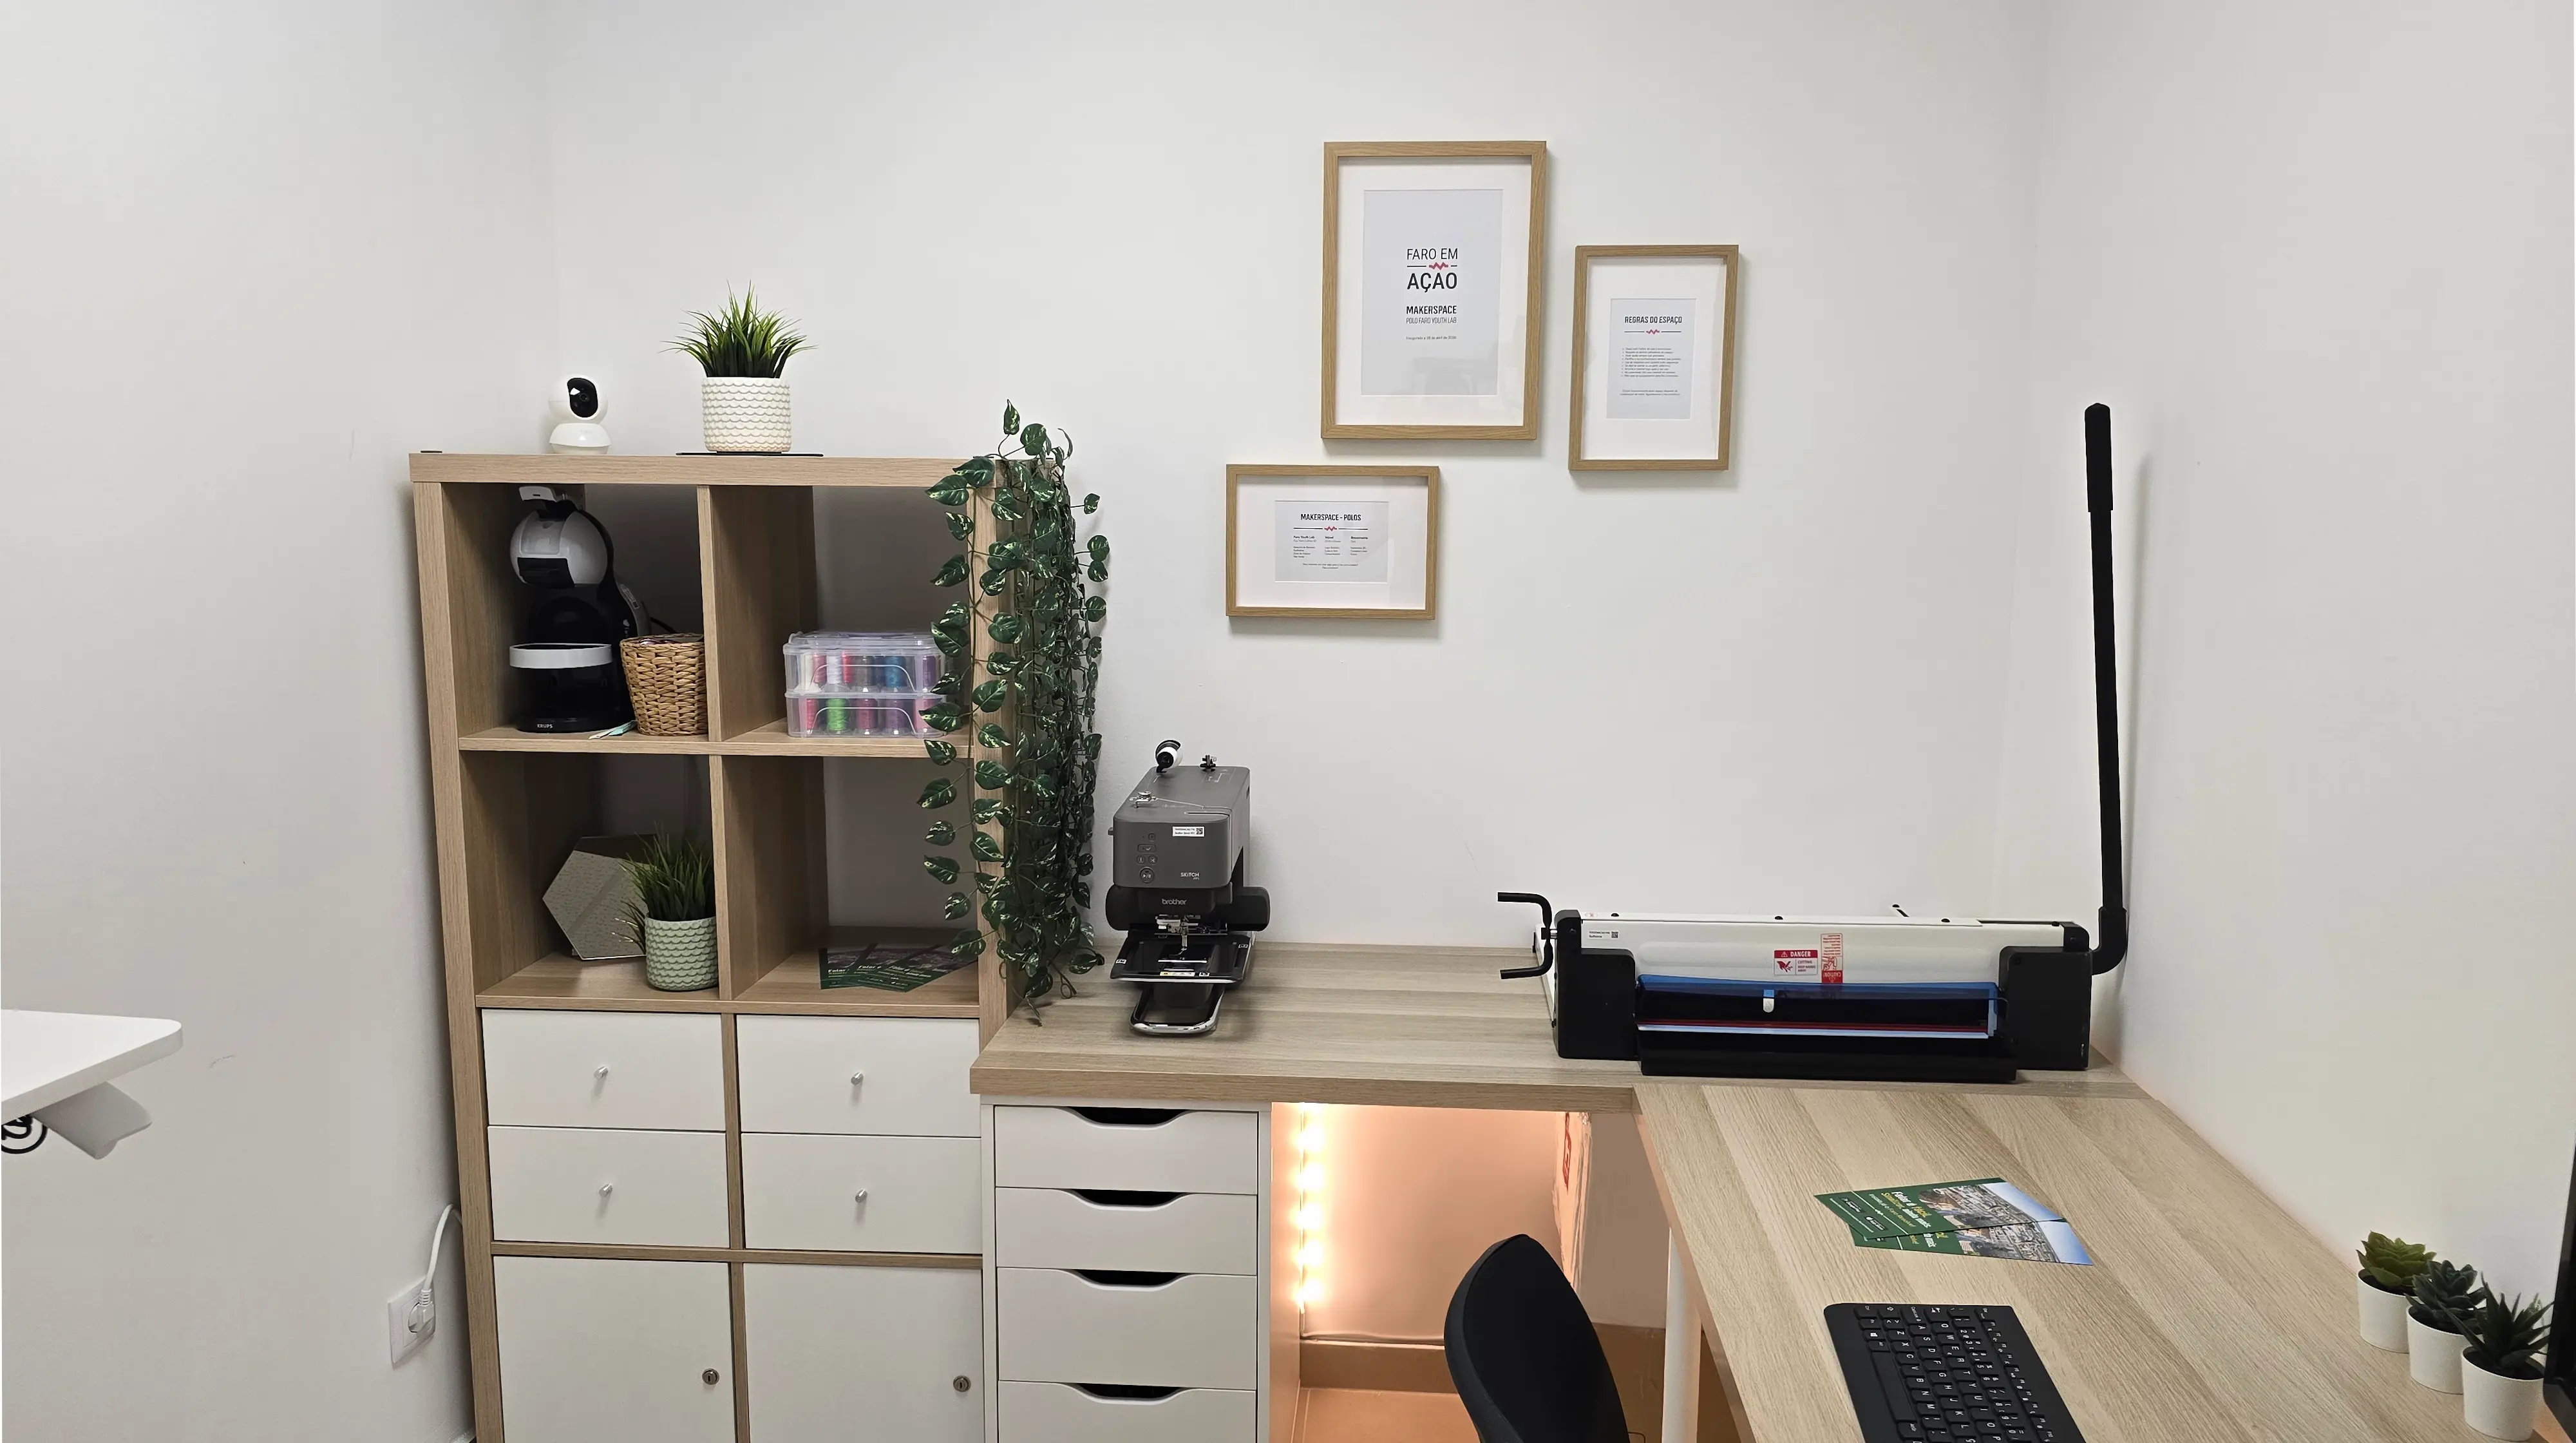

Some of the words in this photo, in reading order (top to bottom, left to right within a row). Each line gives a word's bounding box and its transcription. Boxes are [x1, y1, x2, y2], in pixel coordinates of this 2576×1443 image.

[1406, 248, 1436, 260] FARO
[1441, 247, 1458, 260] EM
[1406, 305, 1457, 314] MAKERSPACE
[1659, 316, 1682, 325] ESPAÇO
